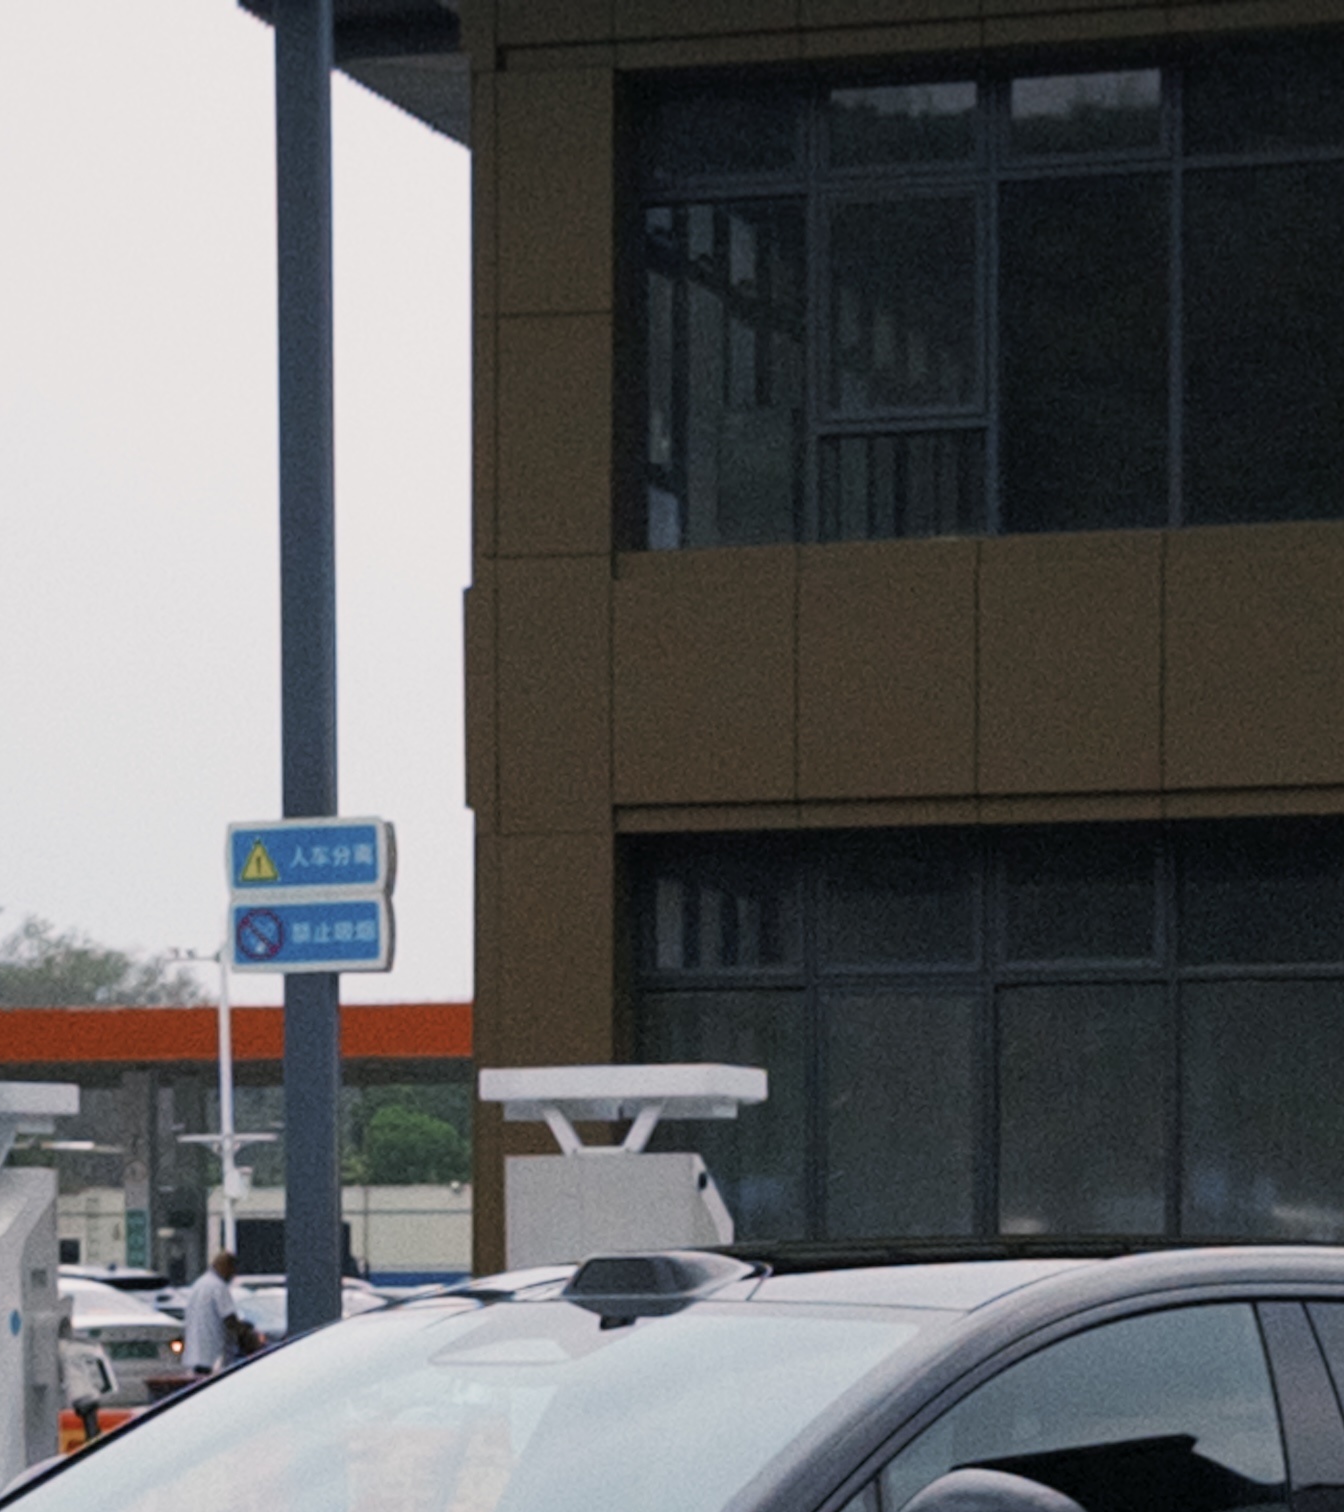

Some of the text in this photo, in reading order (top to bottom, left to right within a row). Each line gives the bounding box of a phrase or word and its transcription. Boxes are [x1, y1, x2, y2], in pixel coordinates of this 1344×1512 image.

[290, 844, 374, 868] 人车分离
[292, 920, 376, 943] 禁止吸烟
